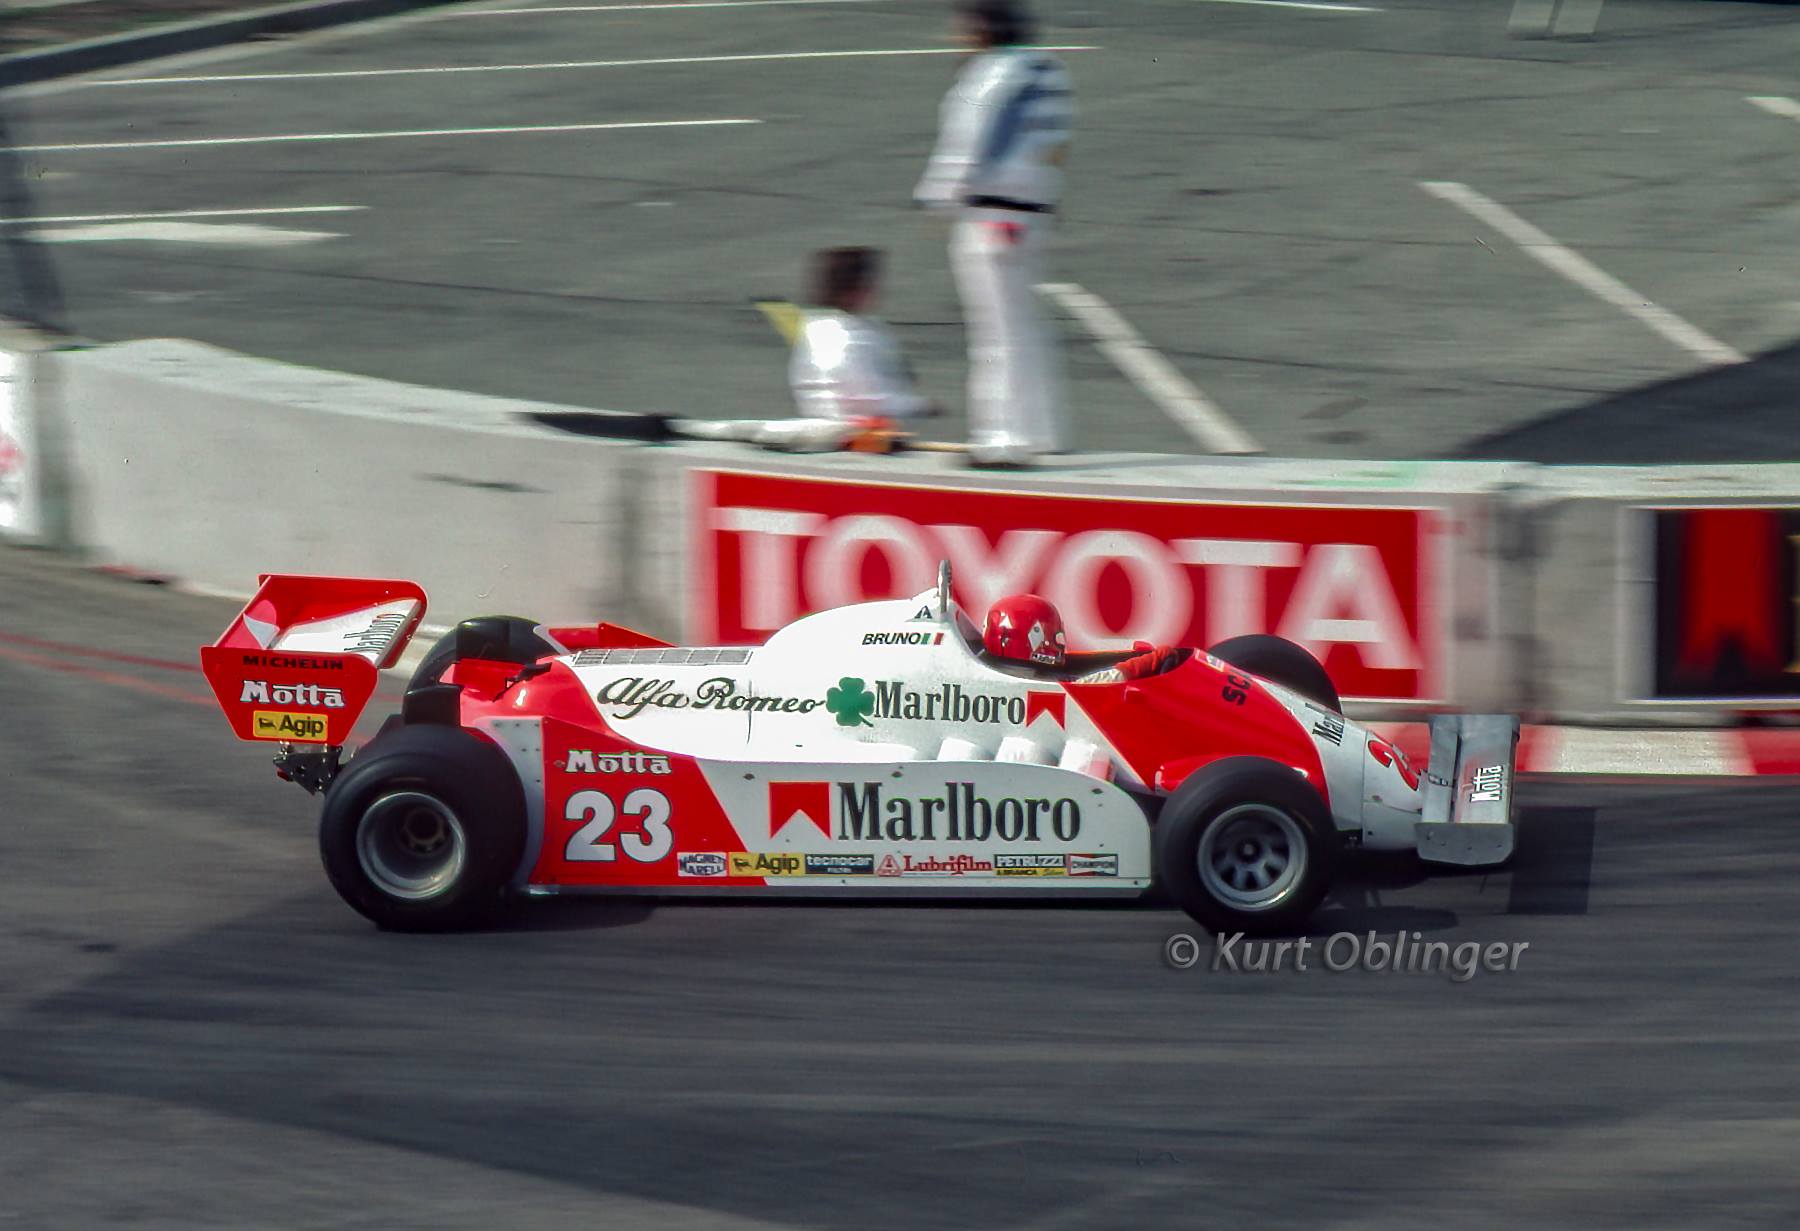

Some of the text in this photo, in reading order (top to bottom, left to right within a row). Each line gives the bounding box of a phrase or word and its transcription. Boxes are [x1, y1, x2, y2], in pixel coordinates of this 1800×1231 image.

[709, 507, 1423, 671] TOYOTA
[861, 632, 921, 646] BRUNO
[242, 654, 344, 671] MICHELIN
[239, 679, 346, 709] Motta
[597, 676, 826, 720] Alfa Romeo
[874, 680, 1026, 725] Marlboro
[278, 713, 325, 738] Agip
[564, 749, 673, 775] Motta
[1470, 765, 1504, 802] Motta
[565, 788, 674, 864] 23
[837, 781, 1081, 842] Marlboro
[755, 852, 800, 874] Agip
